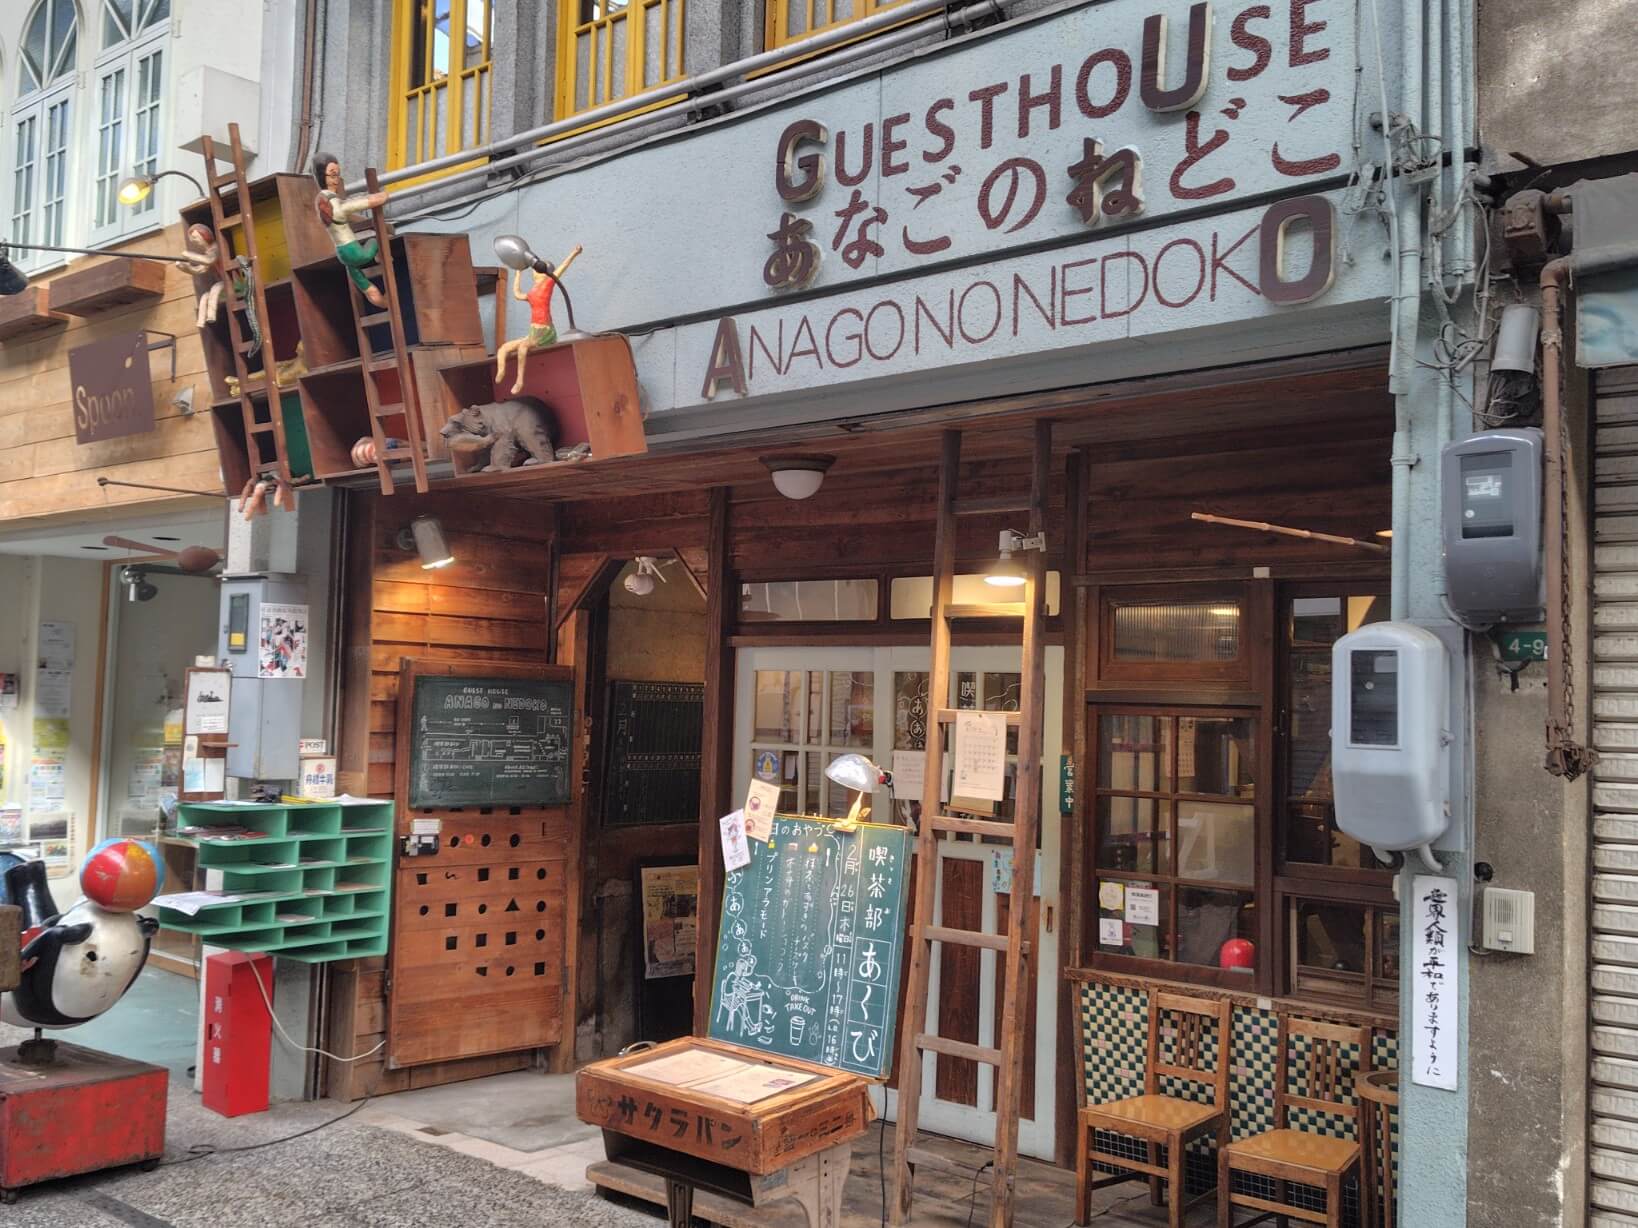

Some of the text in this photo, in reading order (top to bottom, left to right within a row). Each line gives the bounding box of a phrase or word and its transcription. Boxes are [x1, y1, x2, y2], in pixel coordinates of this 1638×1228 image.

[763, 88, 1341, 290] あなごのねどこ
[774, 0, 1331, 203] GUESTHOUSE
[760, 852, 779, 940] プリンアラモード
[863, 845, 889, 932] 喫茶部
[1420, 888, 1448, 1076] 世界人類が平和でありますように
